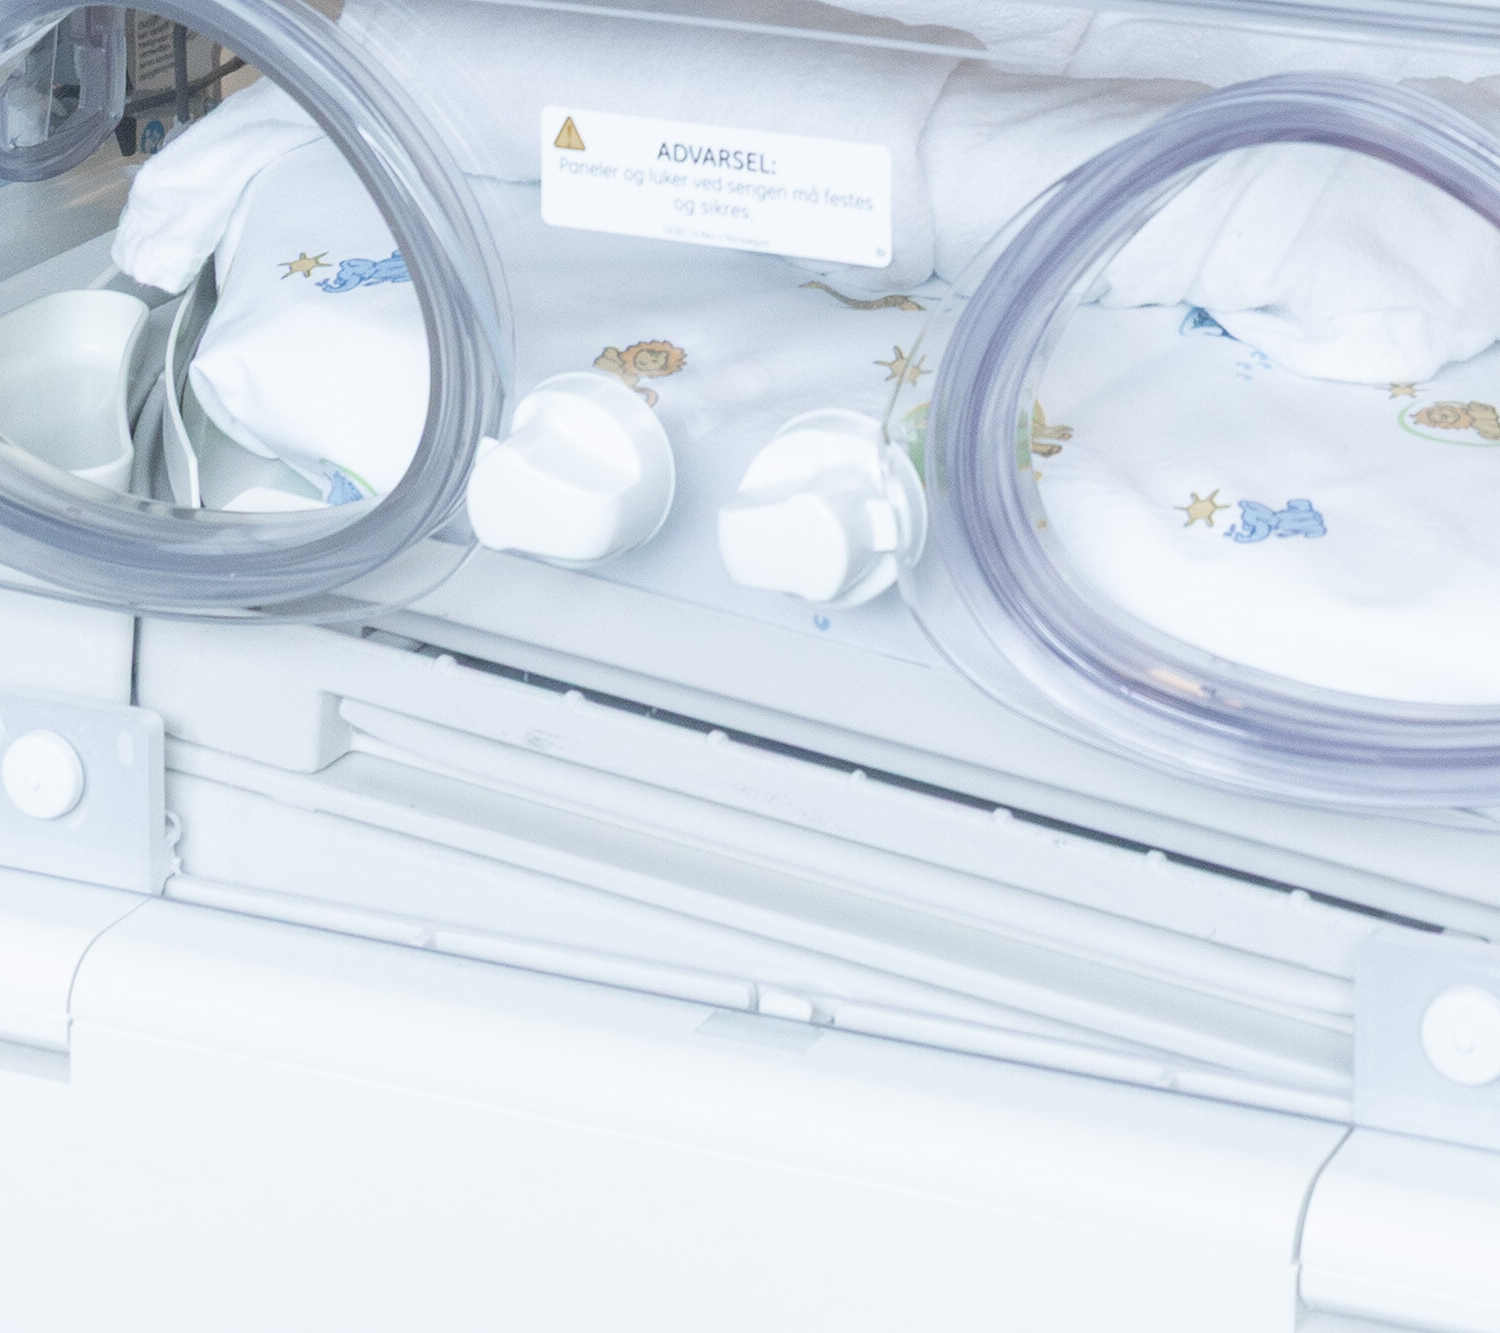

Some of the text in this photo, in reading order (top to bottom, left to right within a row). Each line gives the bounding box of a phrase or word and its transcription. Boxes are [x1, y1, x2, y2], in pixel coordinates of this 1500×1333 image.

[657, 142, 777, 175] ADVARSEL:
[558, 156, 875, 212] Paneler og luker ved sengen må festes
[673, 196, 695, 216] og
